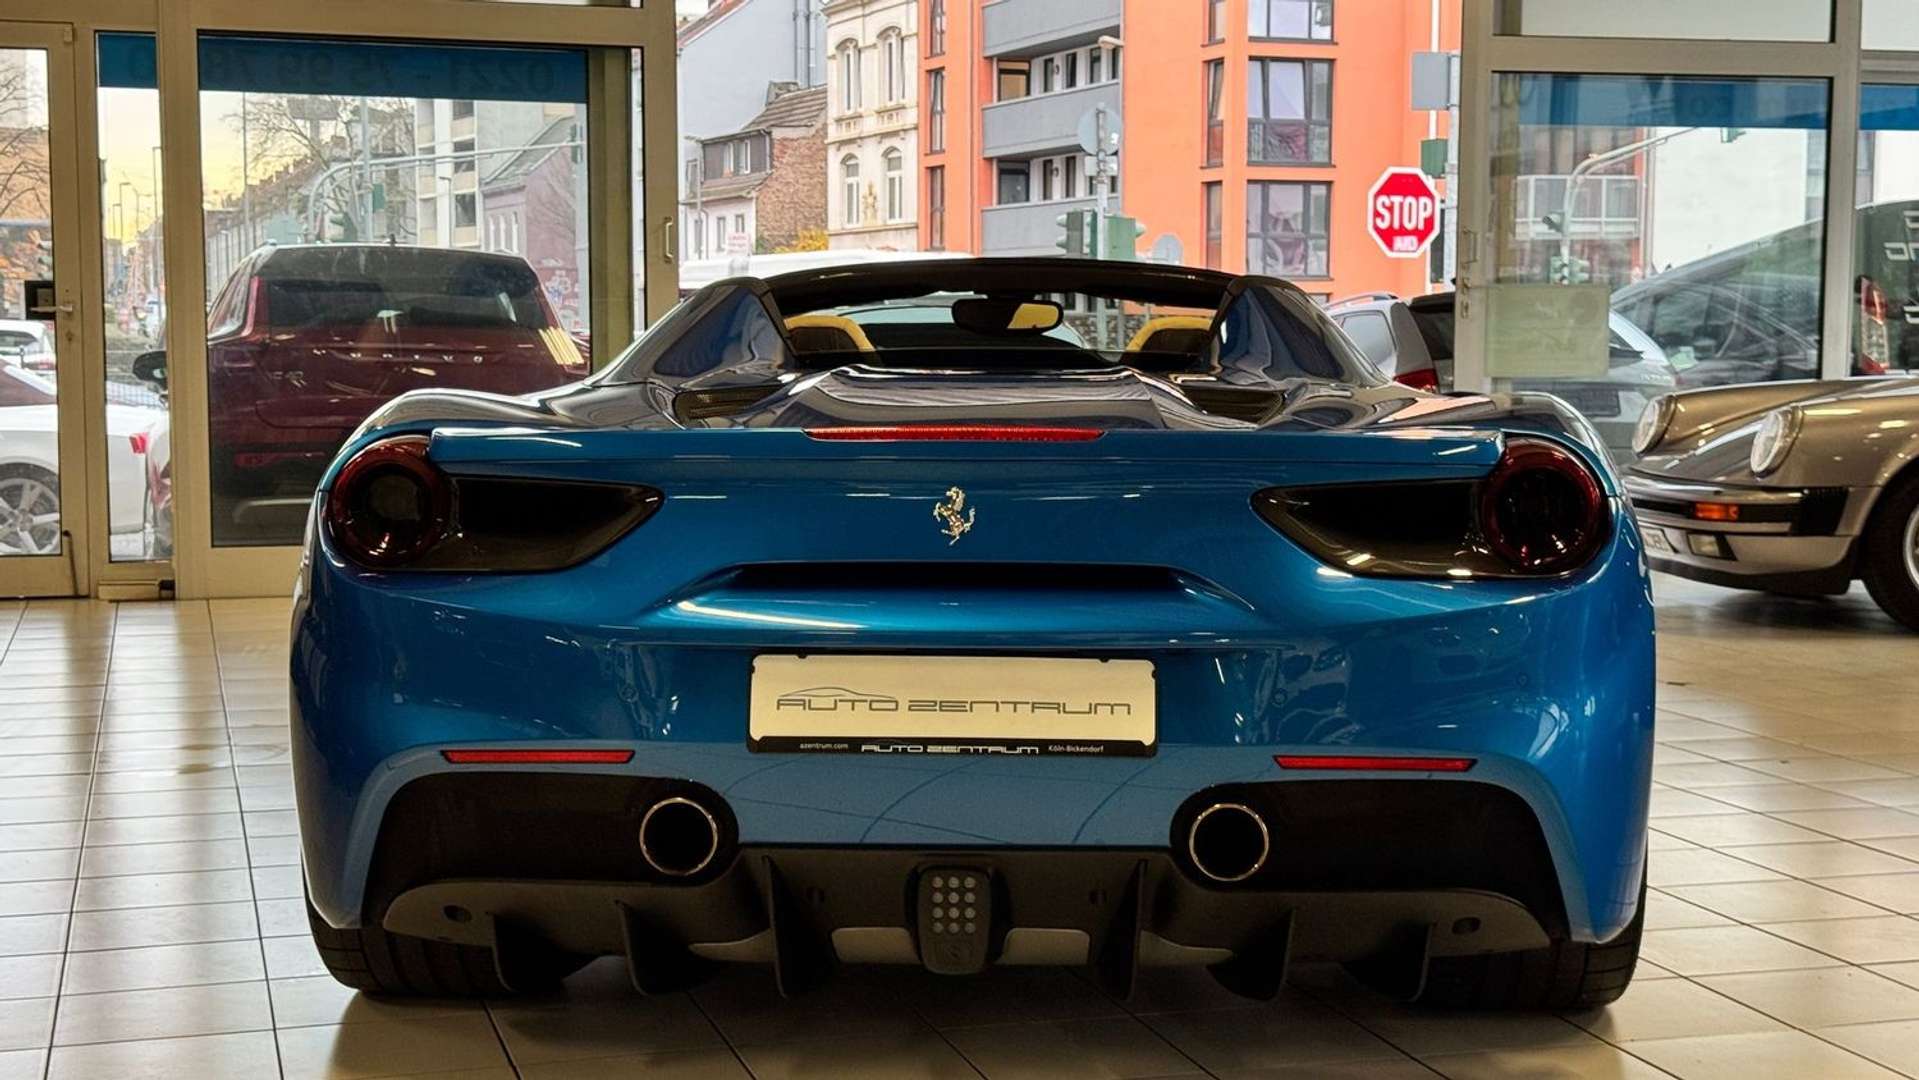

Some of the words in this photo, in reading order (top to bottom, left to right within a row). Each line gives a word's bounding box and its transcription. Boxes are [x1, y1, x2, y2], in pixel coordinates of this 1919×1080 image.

[1375, 195, 1432, 231] STOP
[776, 698, 899, 712] AUTO
[908, 700, 1131, 715] ZENTRUM
[861, 744, 923, 753] AUTO
[926, 745, 1039, 754] ZENTRUM
[1048, 744, 1104, 753] Köln-Bickendorf
